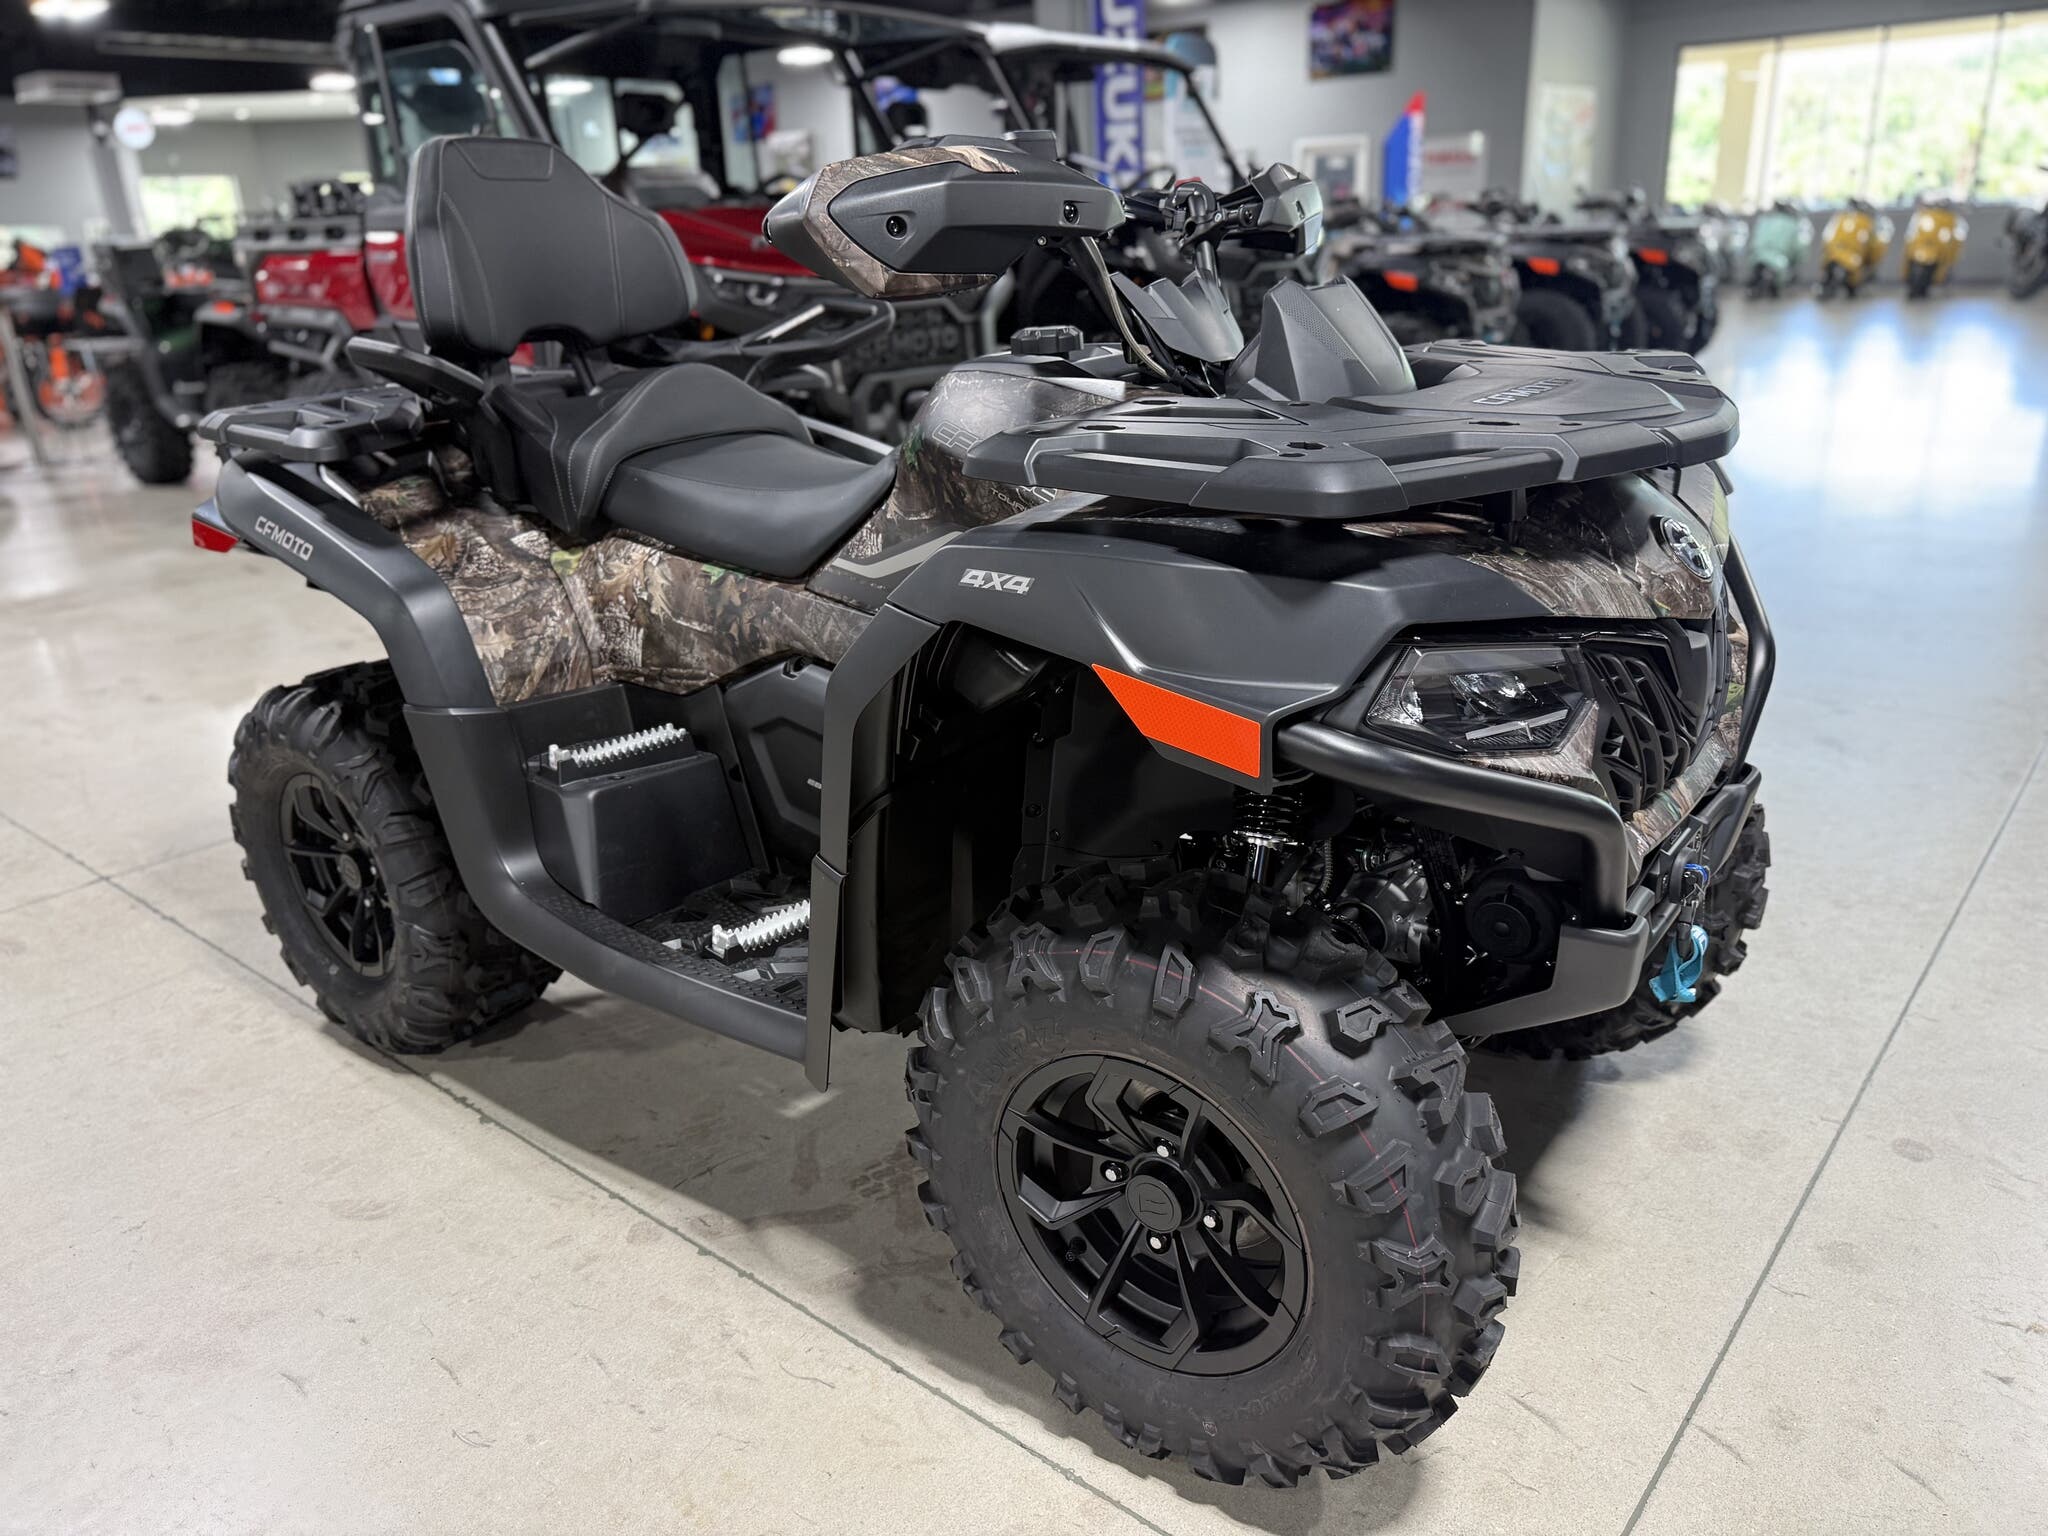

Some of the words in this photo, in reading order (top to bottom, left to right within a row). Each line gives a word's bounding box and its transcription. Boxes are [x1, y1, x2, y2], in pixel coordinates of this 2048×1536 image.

[931, 420, 986, 457] CF
[990, 486, 1028, 514] TOUR
[254, 515, 314, 561] CFMOTO
